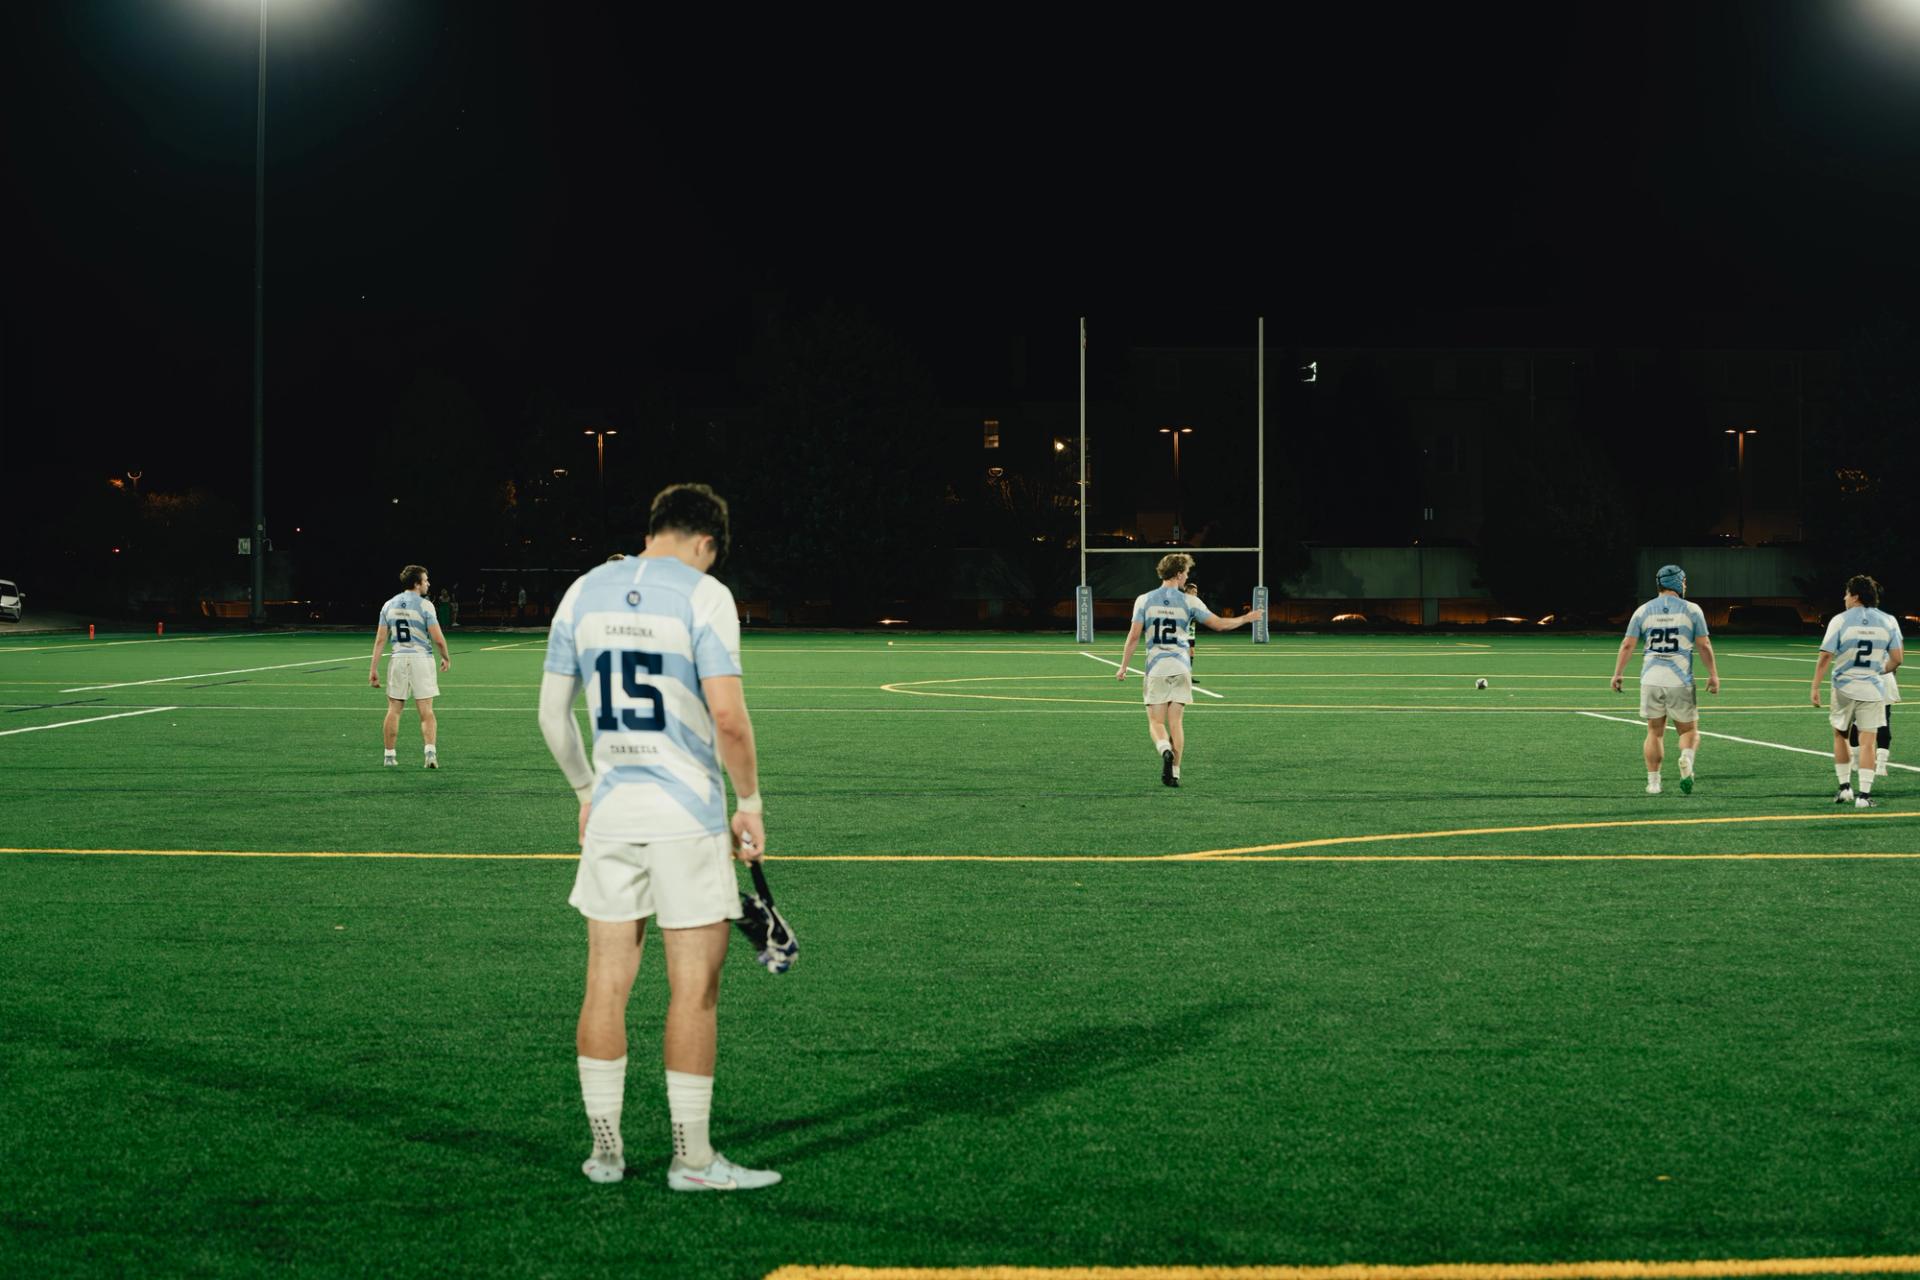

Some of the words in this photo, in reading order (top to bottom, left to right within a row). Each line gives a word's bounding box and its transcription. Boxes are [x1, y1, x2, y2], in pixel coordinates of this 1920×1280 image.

[396, 619, 411, 642] 6
[1153, 617, 1177, 644] 12
[1649, 627, 1679, 653] 25
[1854, 640, 1873, 667] 2
[595, 650, 666, 731] 15
